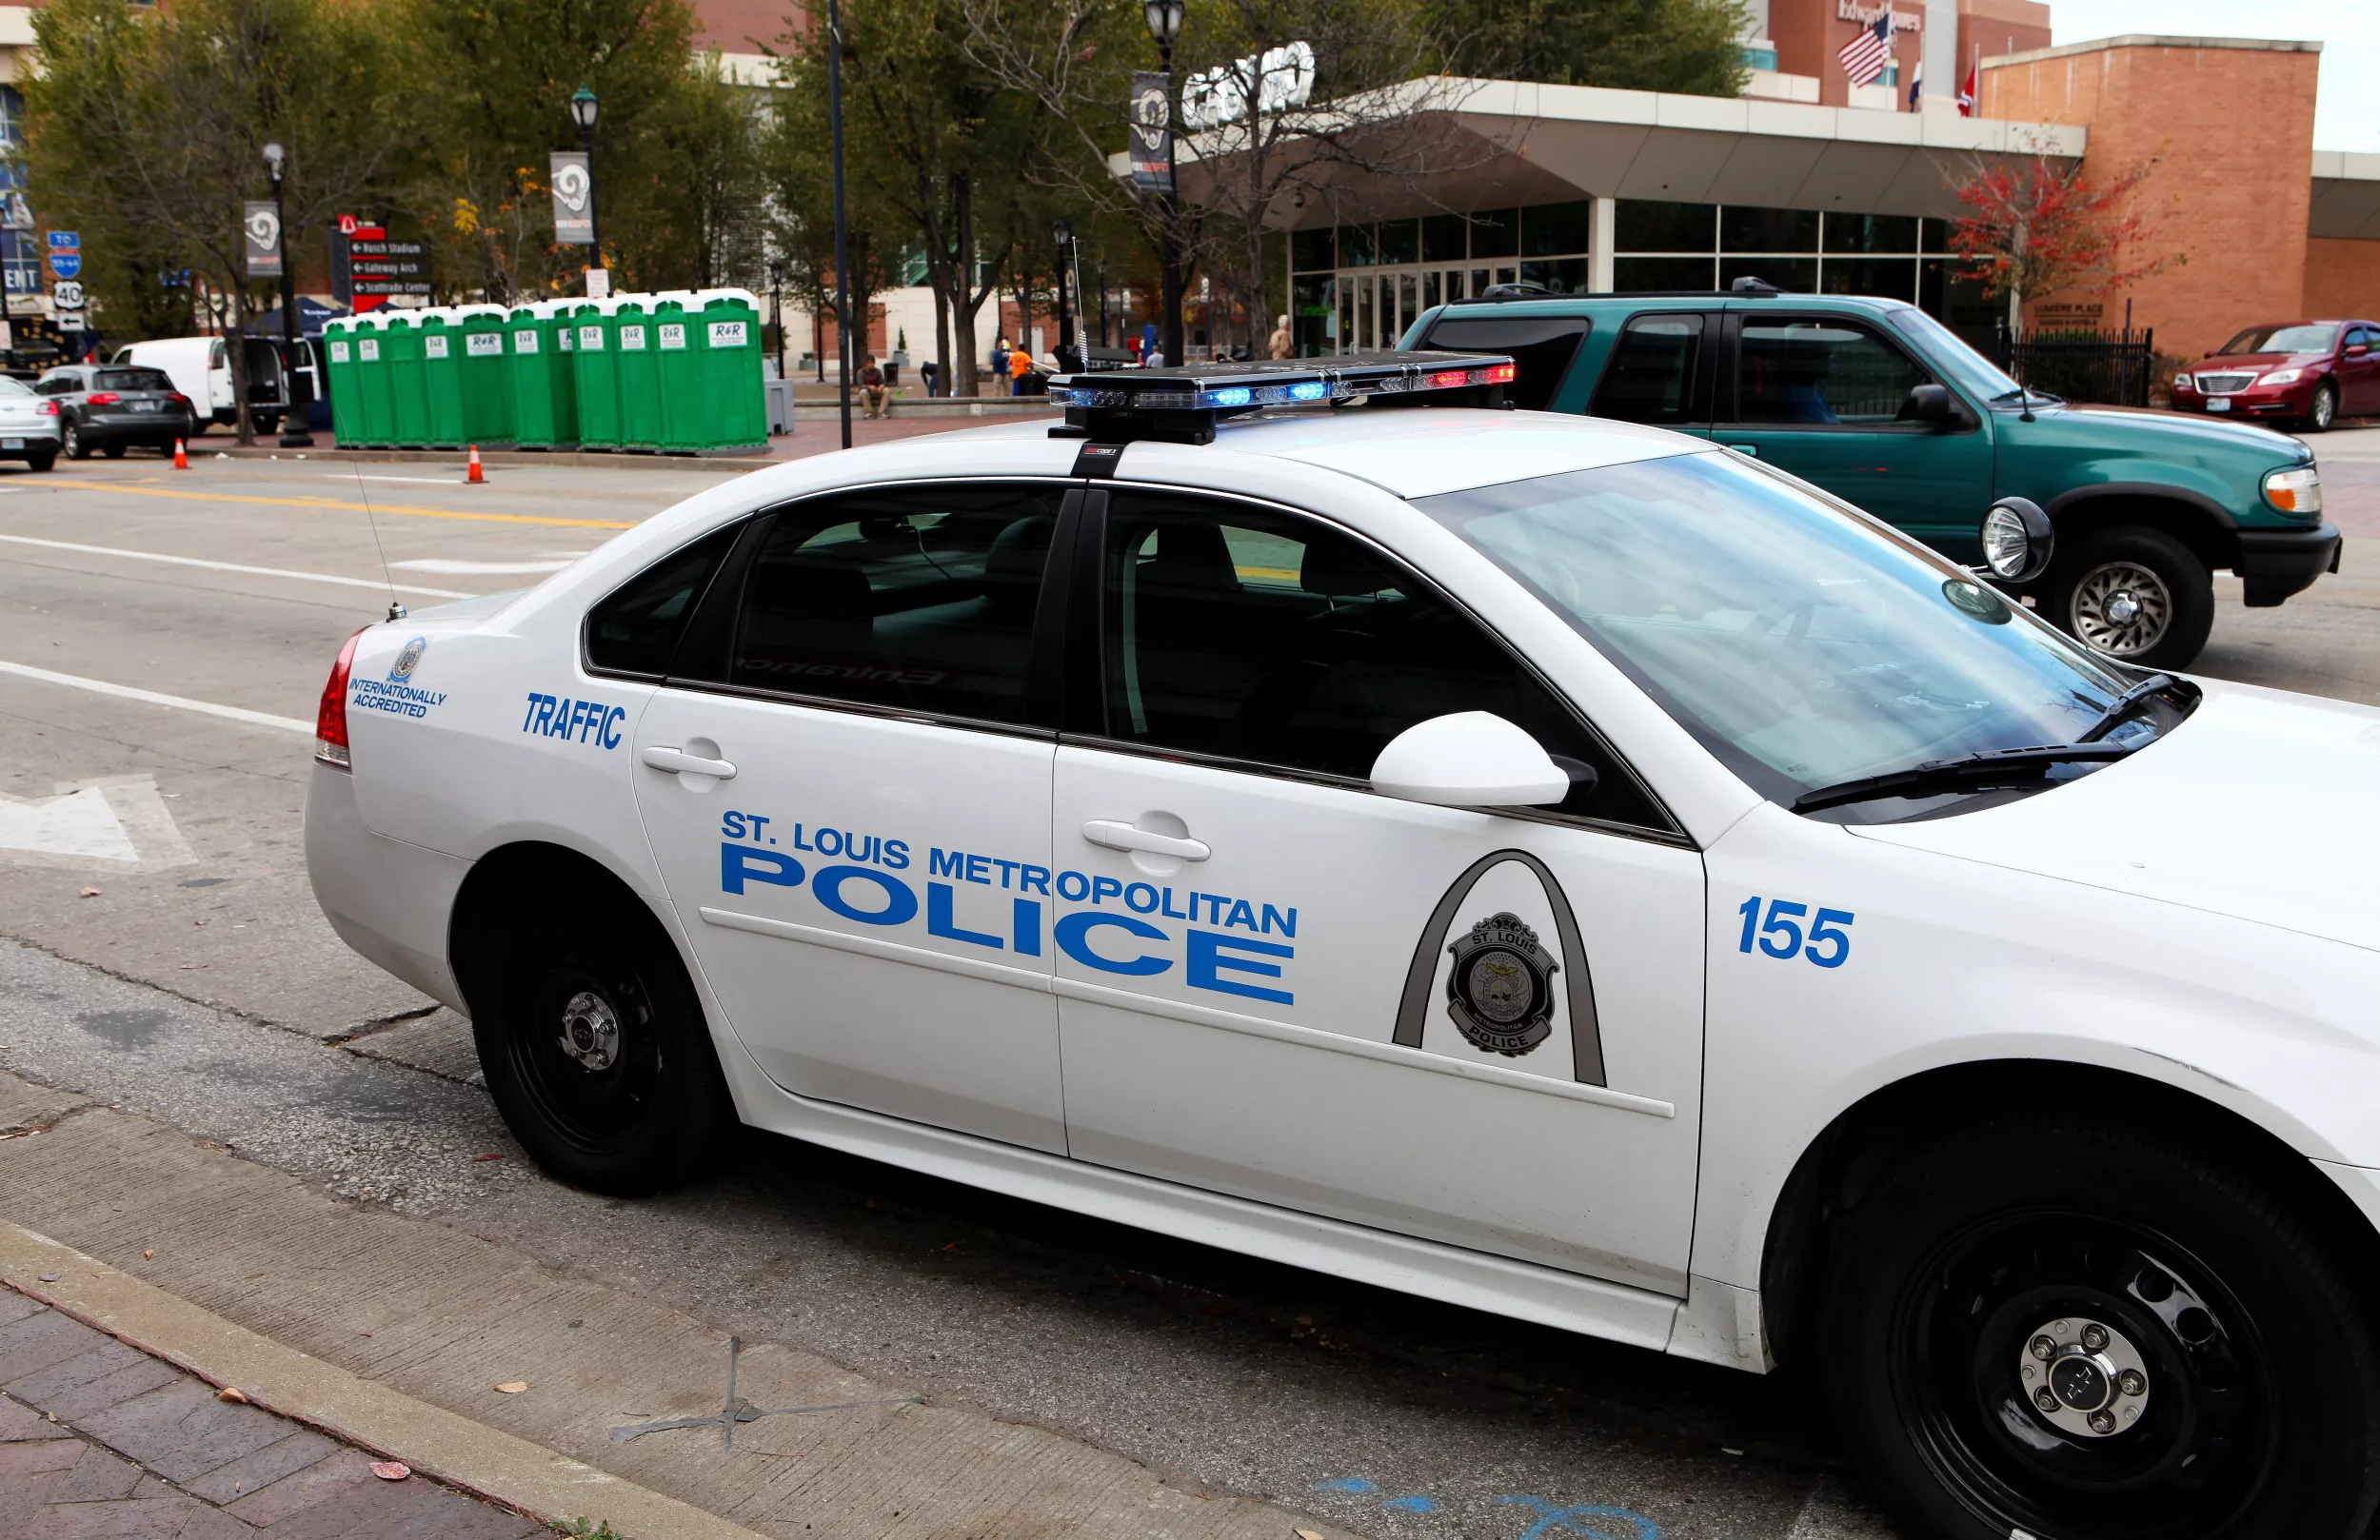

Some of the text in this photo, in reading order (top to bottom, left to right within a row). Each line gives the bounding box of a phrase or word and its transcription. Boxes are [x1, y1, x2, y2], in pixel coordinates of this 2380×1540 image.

[54, 234, 72, 245] TO
[363, 243, 422, 254] Busch Stadium
[365, 263, 418, 275] Gateway Arch
[58, 286, 82, 303] 40
[405, 283, 431, 293] Center
[583, 327, 598, 339] R&R
[625, 327, 640, 340] R&R
[664, 326, 680, 338] R&R
[716, 325, 741, 336] R&R
[472, 335, 497, 346] R&R
[348, 678, 447, 706] INTERNATIONALLY
[352, 693, 427, 719] ACCREDITED
[524, 692, 625, 750] TRAFFIC
[721, 810, 1298, 938] ST. LOUIS METROPOLITAN
[721, 841, 1295, 1006] POLICE
[1739, 896, 1854, 969] 155
[1472, 931, 1537, 956] ST. LOUIS
[1473, 1012, 1523, 1032] METROPOLITAN
[1468, 1024, 1529, 1048] POLICE
